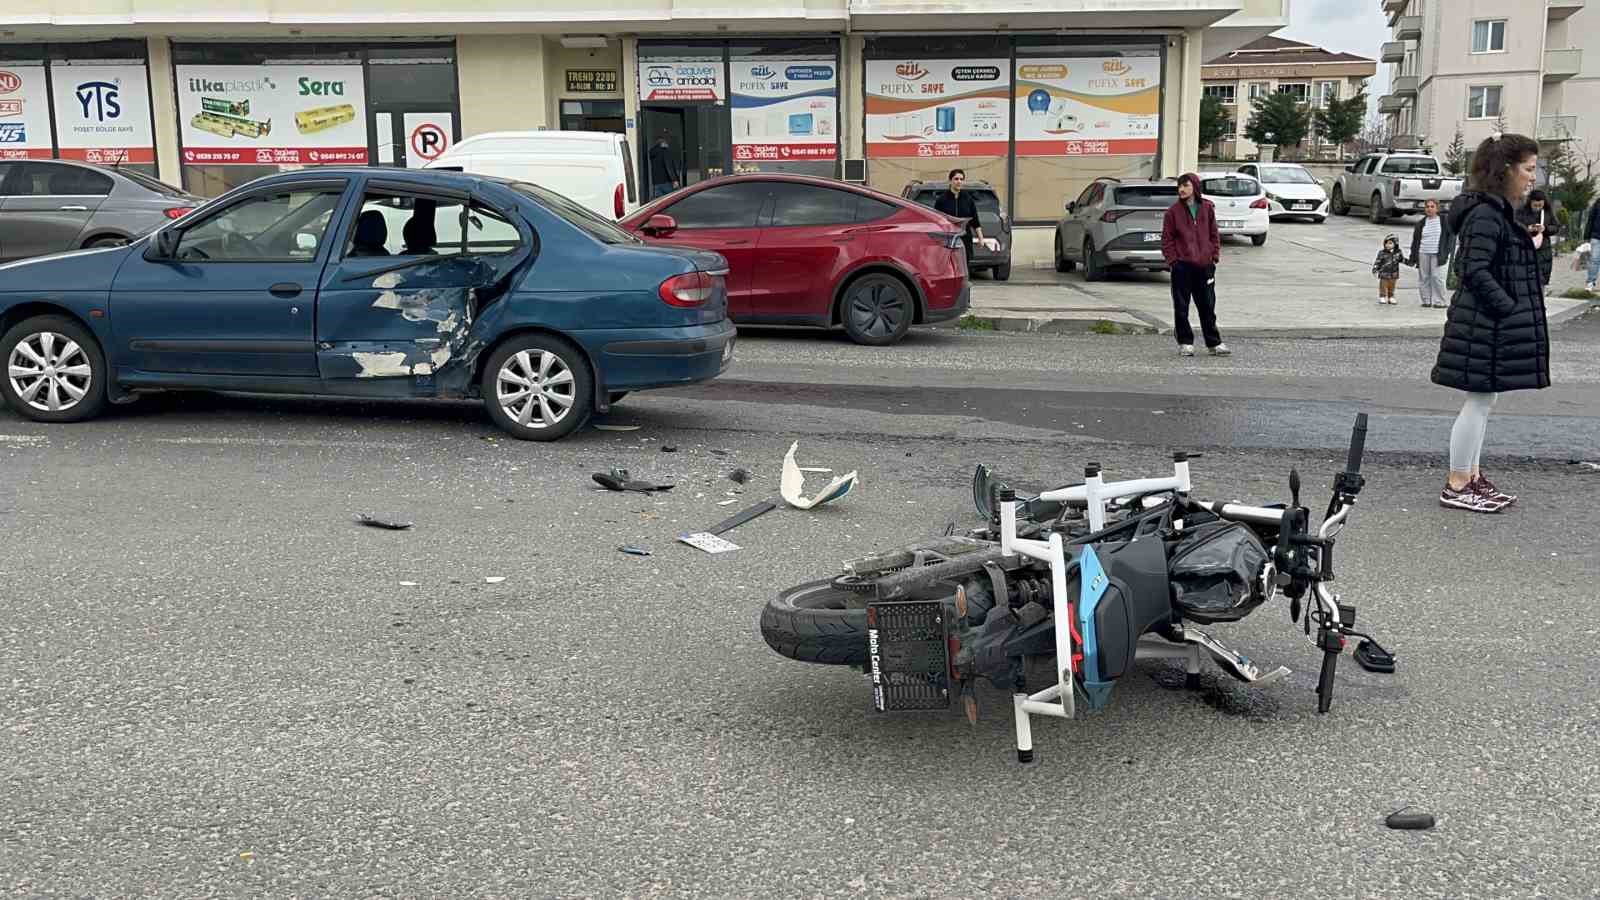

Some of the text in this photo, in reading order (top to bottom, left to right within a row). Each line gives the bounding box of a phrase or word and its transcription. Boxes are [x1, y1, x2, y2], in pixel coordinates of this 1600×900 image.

[298, 77, 344, 96] Sera
[921, 83, 945, 94] SAVE
[76, 81, 121, 122] YTS
[422, 131, 438, 153] P
[868, 629, 879, 655] Moto
[871, 655, 882, 684] Center
